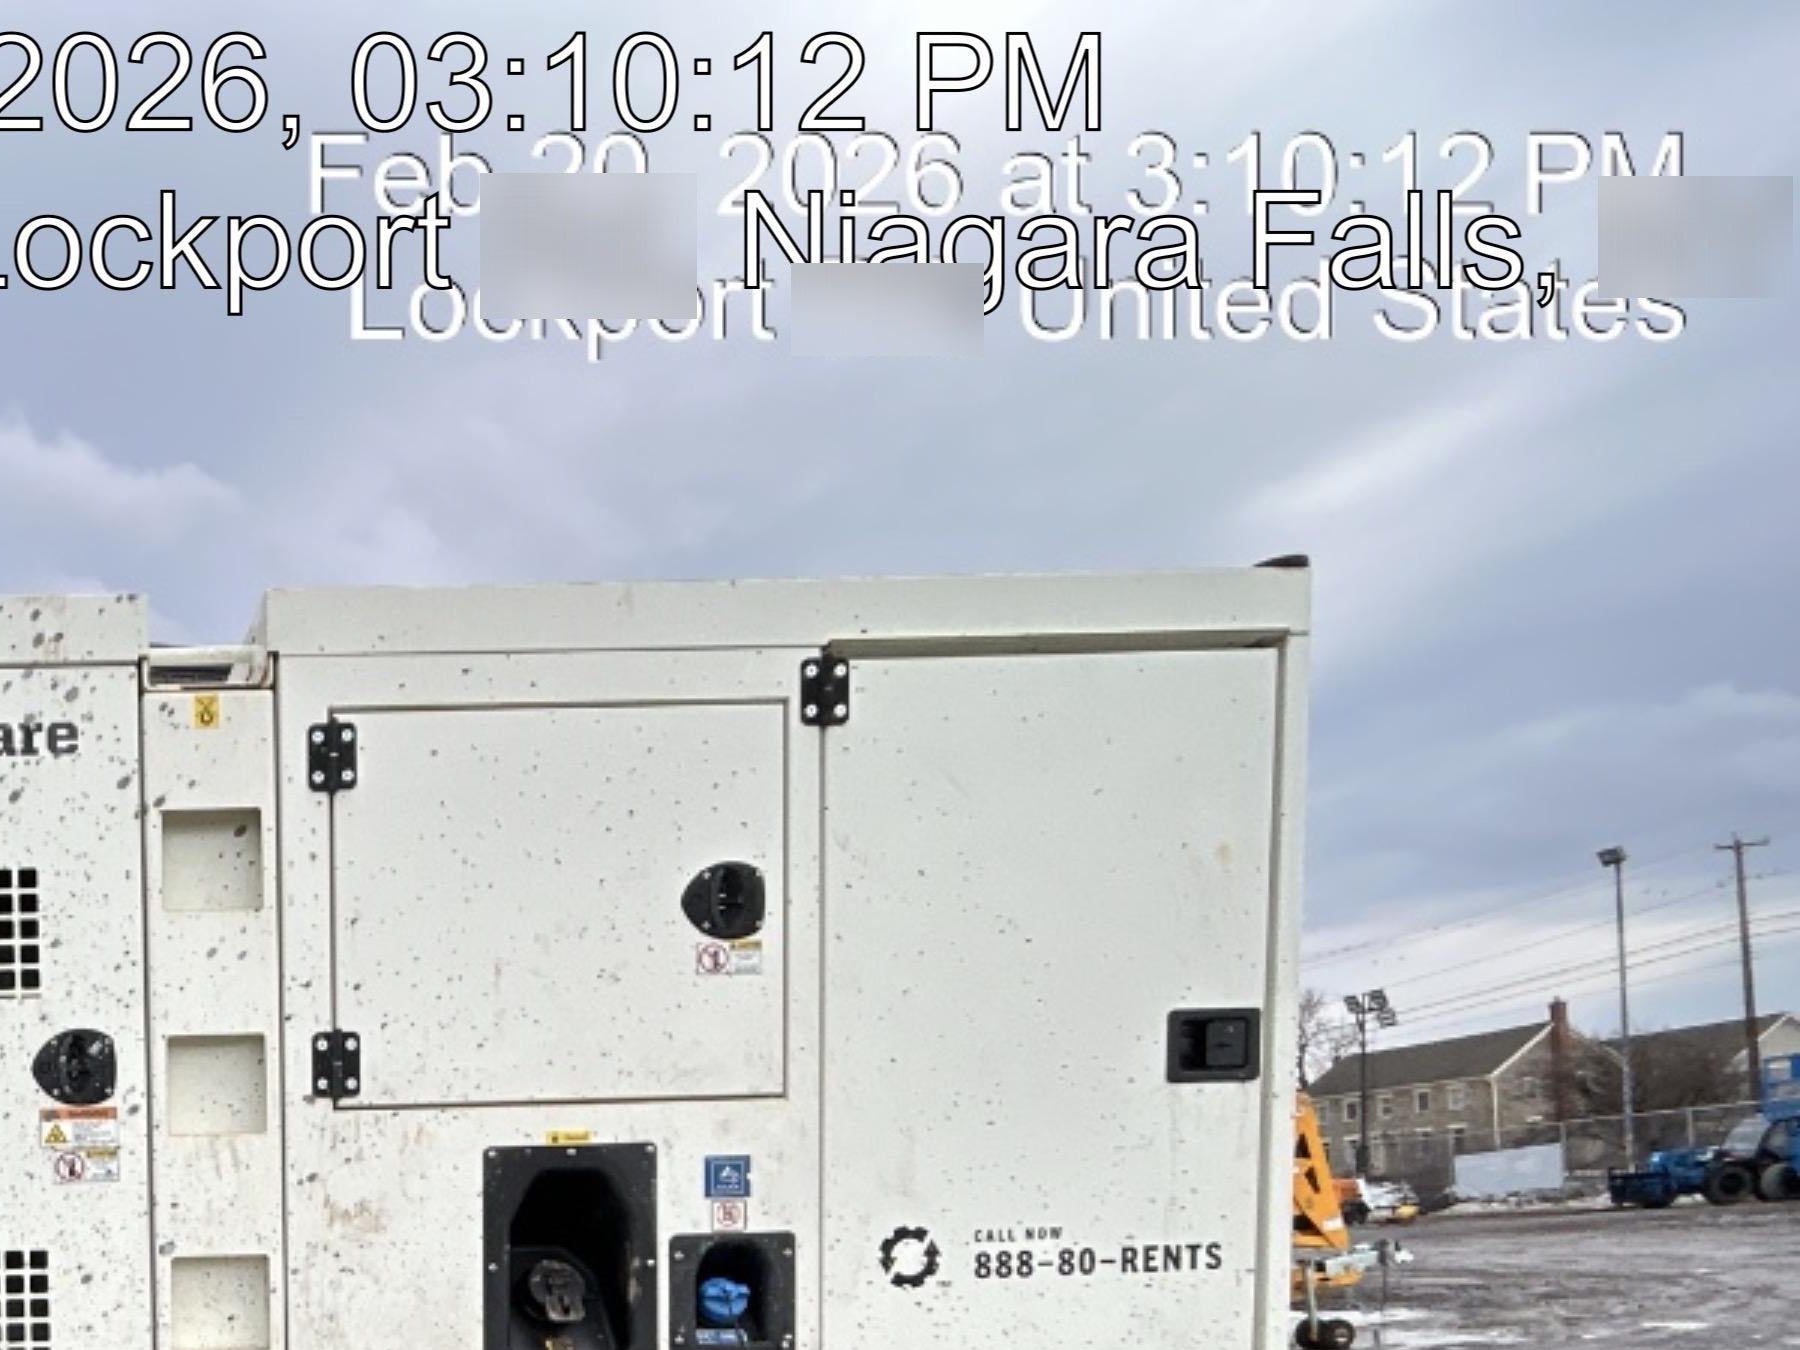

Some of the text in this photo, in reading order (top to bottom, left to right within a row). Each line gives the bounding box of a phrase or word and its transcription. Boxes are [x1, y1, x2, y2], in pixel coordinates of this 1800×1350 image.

[973, 1226, 1063, 1243] CALL NOW
[973, 1242, 1223, 1280] 888-80-RENTS
